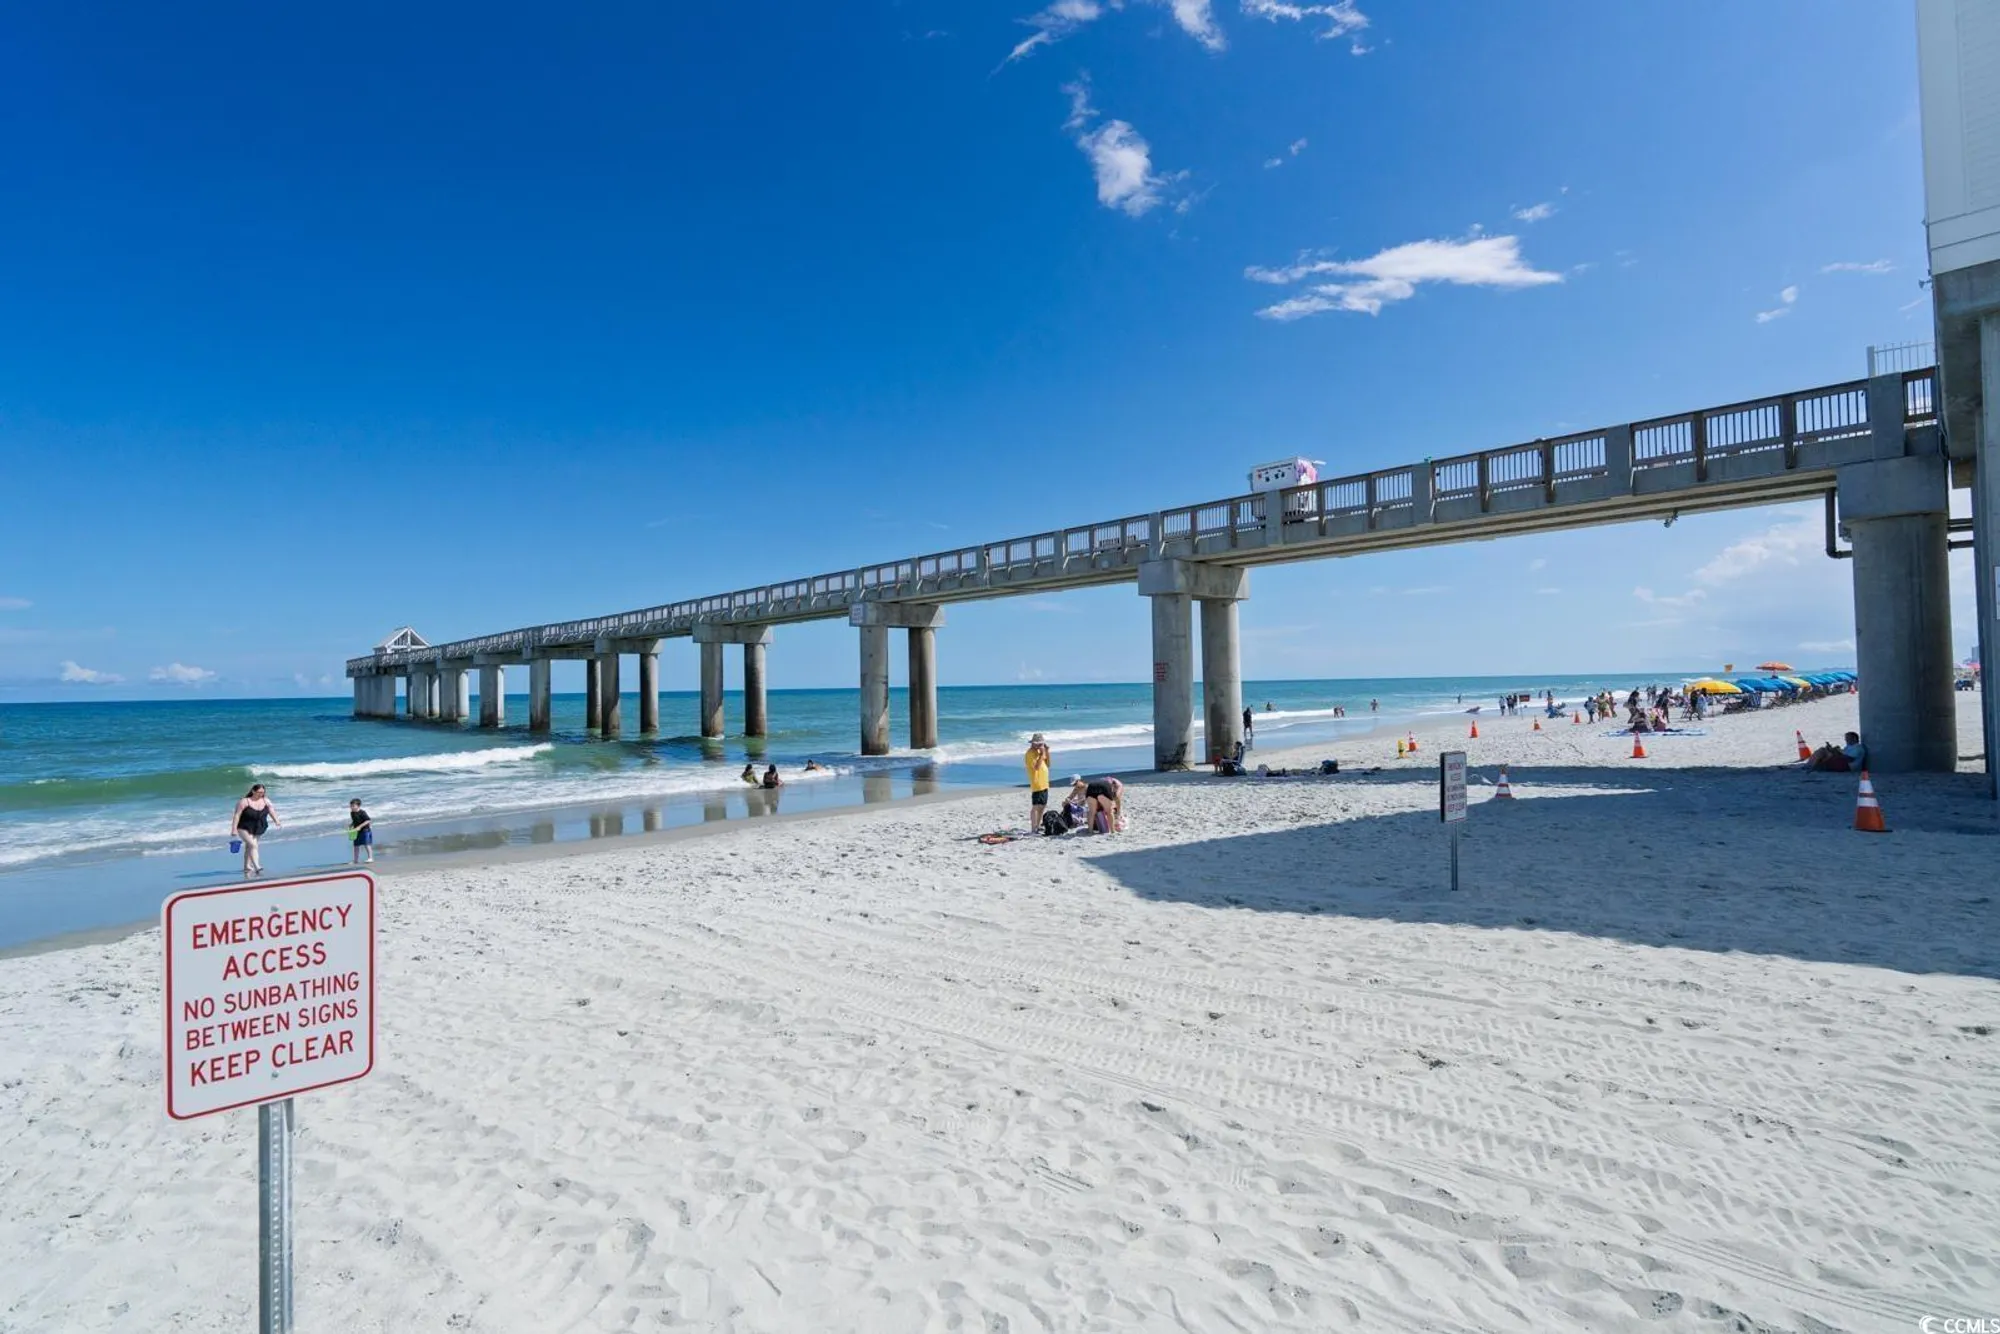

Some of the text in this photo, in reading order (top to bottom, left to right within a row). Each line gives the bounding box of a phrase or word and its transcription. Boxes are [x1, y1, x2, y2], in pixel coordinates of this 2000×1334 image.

[192, 904, 352, 950] EMERGENCY
[222, 942, 327, 981] ACCESS
[184, 971, 359, 1021] NO SUNBATHING
[186, 999, 358, 1051] BETWEEN SIGNS
[191, 1030, 354, 1087] KEEP CLEAR
